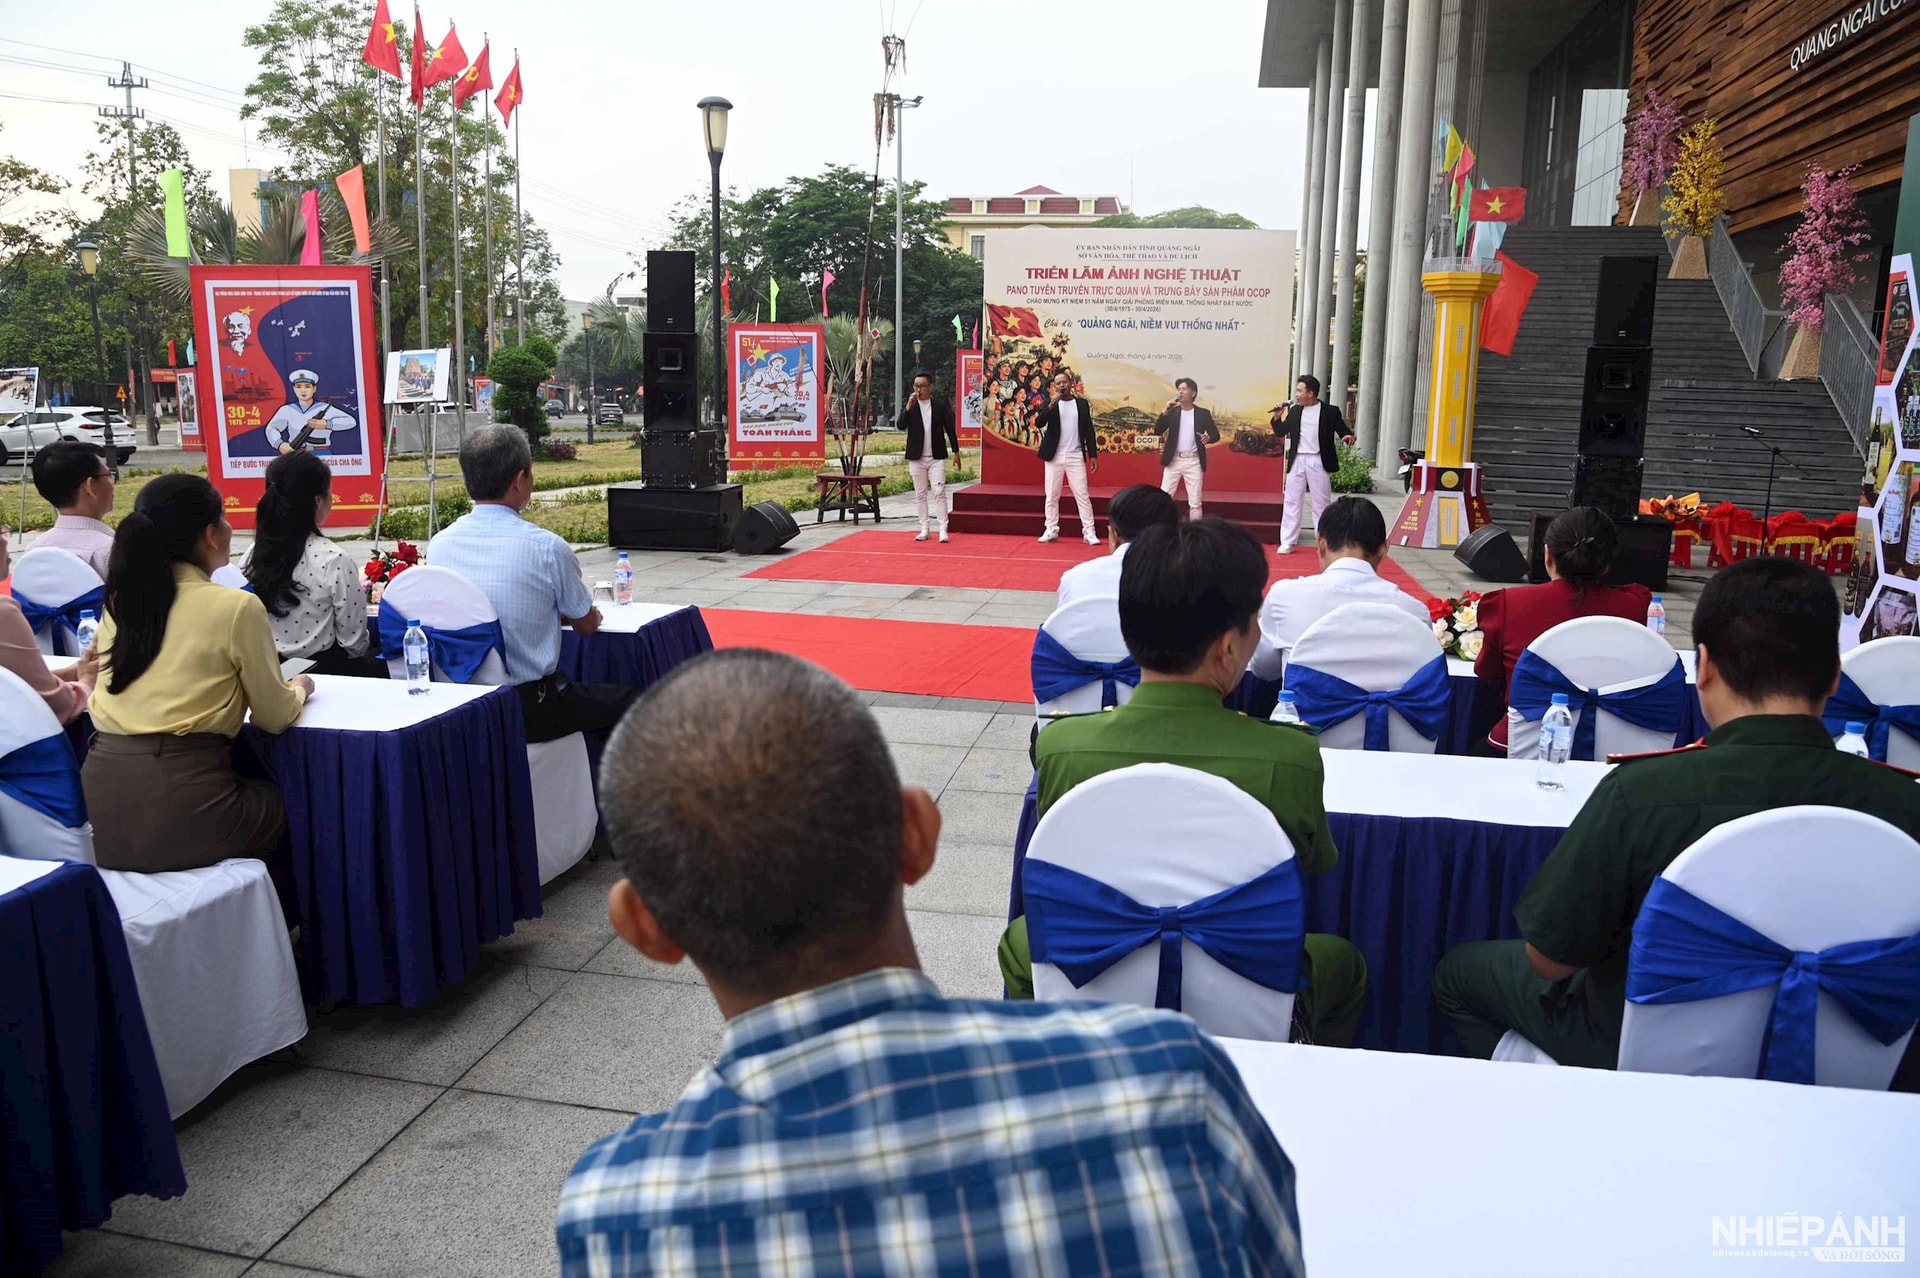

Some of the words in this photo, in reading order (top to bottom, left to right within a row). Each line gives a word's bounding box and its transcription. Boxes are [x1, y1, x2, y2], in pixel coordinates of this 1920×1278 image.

[1790, 23, 1838, 71] QUANG
[1025, 265, 1069, 280] TRIỂN
[1072, 265, 1104, 280] LÃM
[1107, 265, 1139, 280] ẢNH
[1143, 267, 1186, 283] NGHỆ
[1190, 268, 1242, 284] THUẬT
[1006, 285, 1028, 295] PANO
[1091, 286, 1114, 298] TRỰC
[1115, 286, 1139, 296] QUAN
[1140, 284, 1151, 296] VÀ
[1154, 286, 1182, 297] TRƯNG
[1184, 284, 1201, 297] BÀY
[1246, 288, 1271, 298] OCOP
[1114, 317, 1138, 330] NGÃI,
[1140, 316, 1162, 329] NIỀM
[1164, 320, 1179, 330] VUI
[1181, 317, 1213, 330] THỐNG
[228, 405, 261, 419] 30-4
[743, 428, 772, 436] TOÀN
[773, 427, 812, 436] THẮNG
